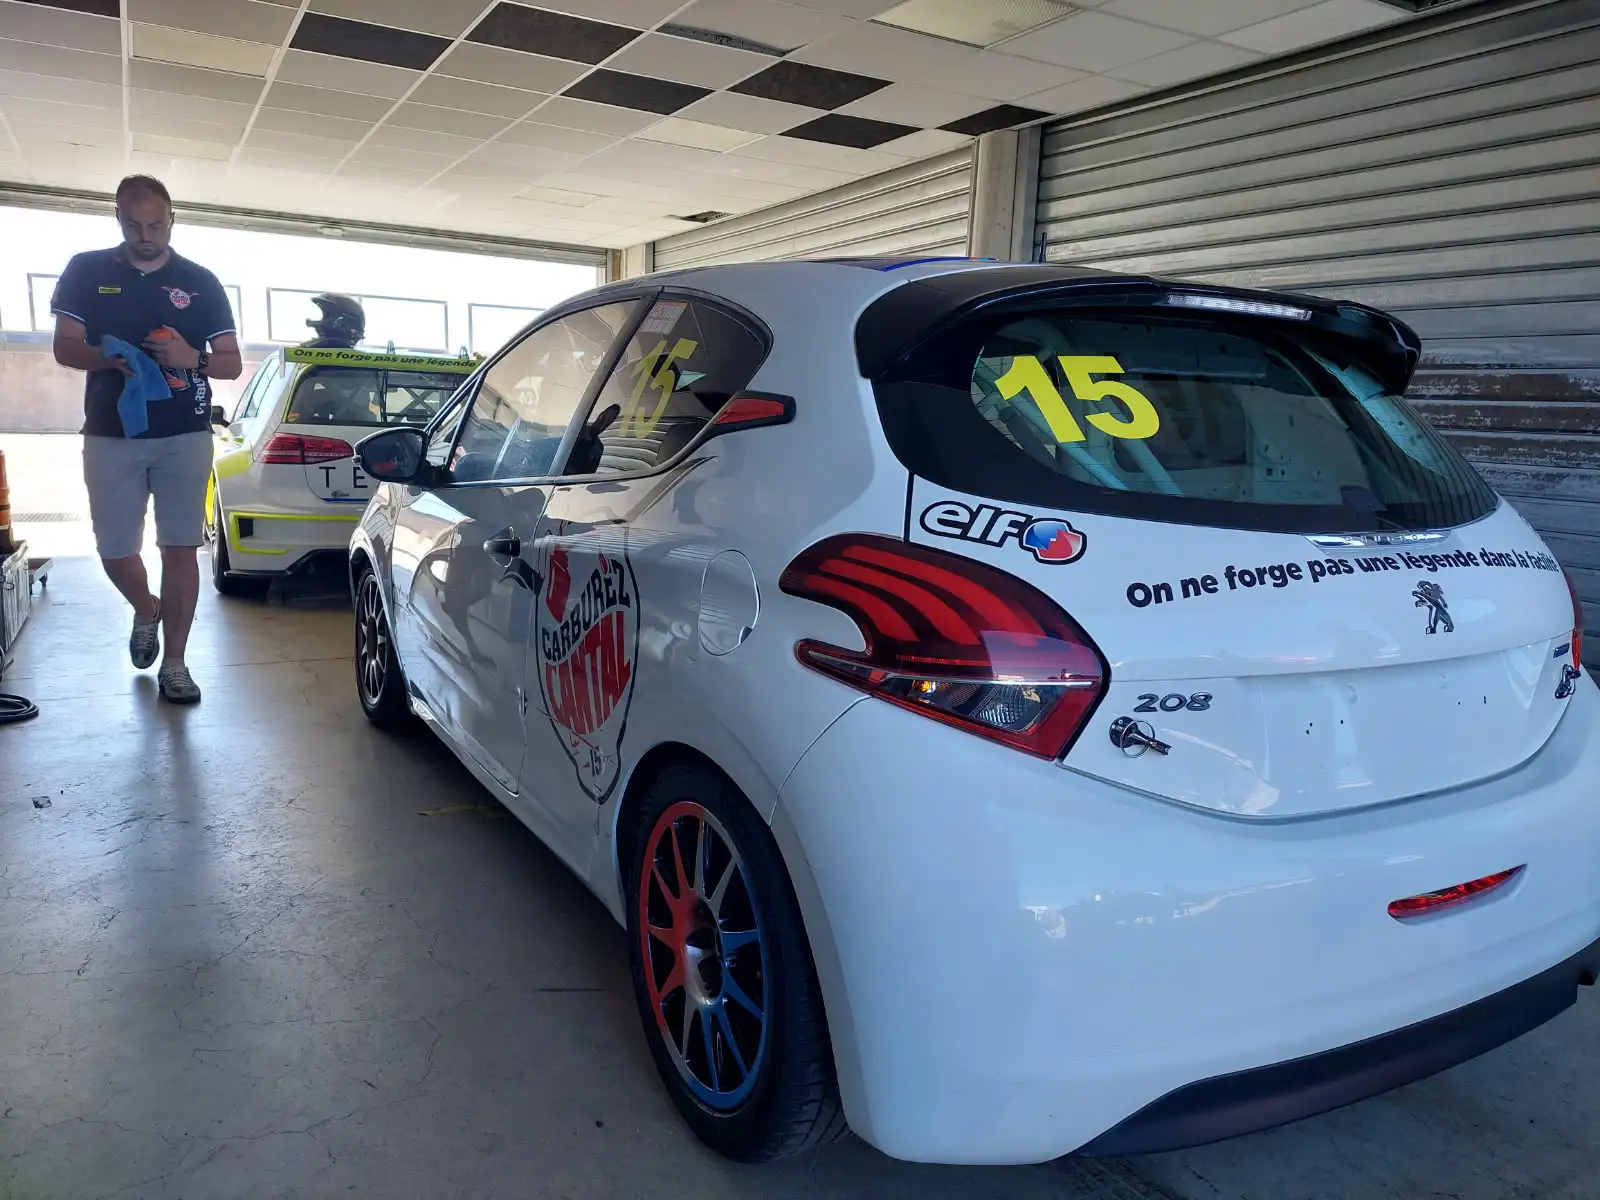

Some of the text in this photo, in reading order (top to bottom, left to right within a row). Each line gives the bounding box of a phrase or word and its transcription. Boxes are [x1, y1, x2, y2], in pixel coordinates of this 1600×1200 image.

[294, 349, 312, 357] On
[336, 352, 372, 361] forge
[401, 356, 424, 364] une
[617, 338, 698, 439] 15
[994, 356, 1160, 443] 15
[919, 500, 1033, 549] elf
[1126, 582, 1174, 608] On
[1180, 574, 1219, 599] ne
[1224, 565, 1303, 590] forge
[1307, 558, 1355, 583] pas
[1354, 557, 1401, 572] une
[1479, 547, 1517, 567] dans
[1511, 549, 1530, 568] la
[545, 610, 631, 735] CANTAL
[1133, 692, 1213, 713] 208
